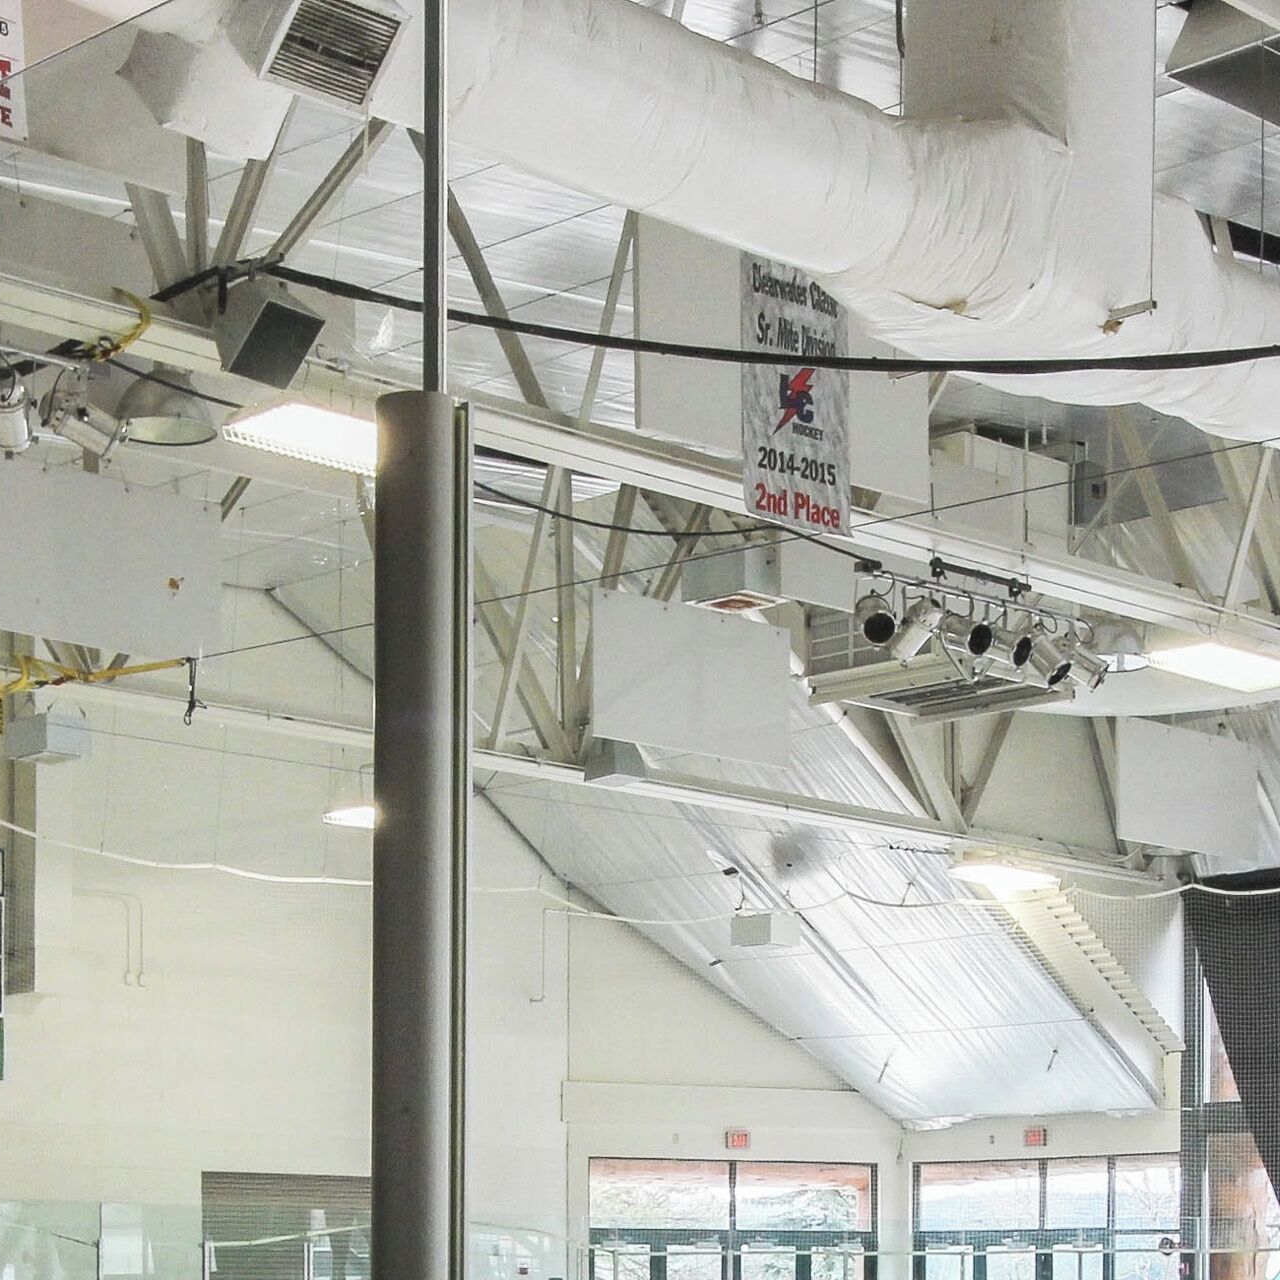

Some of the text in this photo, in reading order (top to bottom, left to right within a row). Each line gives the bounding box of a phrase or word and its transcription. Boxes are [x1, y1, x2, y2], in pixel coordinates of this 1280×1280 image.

[757, 310, 773, 346] Sr.
[792, 423, 823, 441] HOCKEY
[758, 446, 836, 487] 2014-2015
[755, 482, 840, 529] 2nd Place
